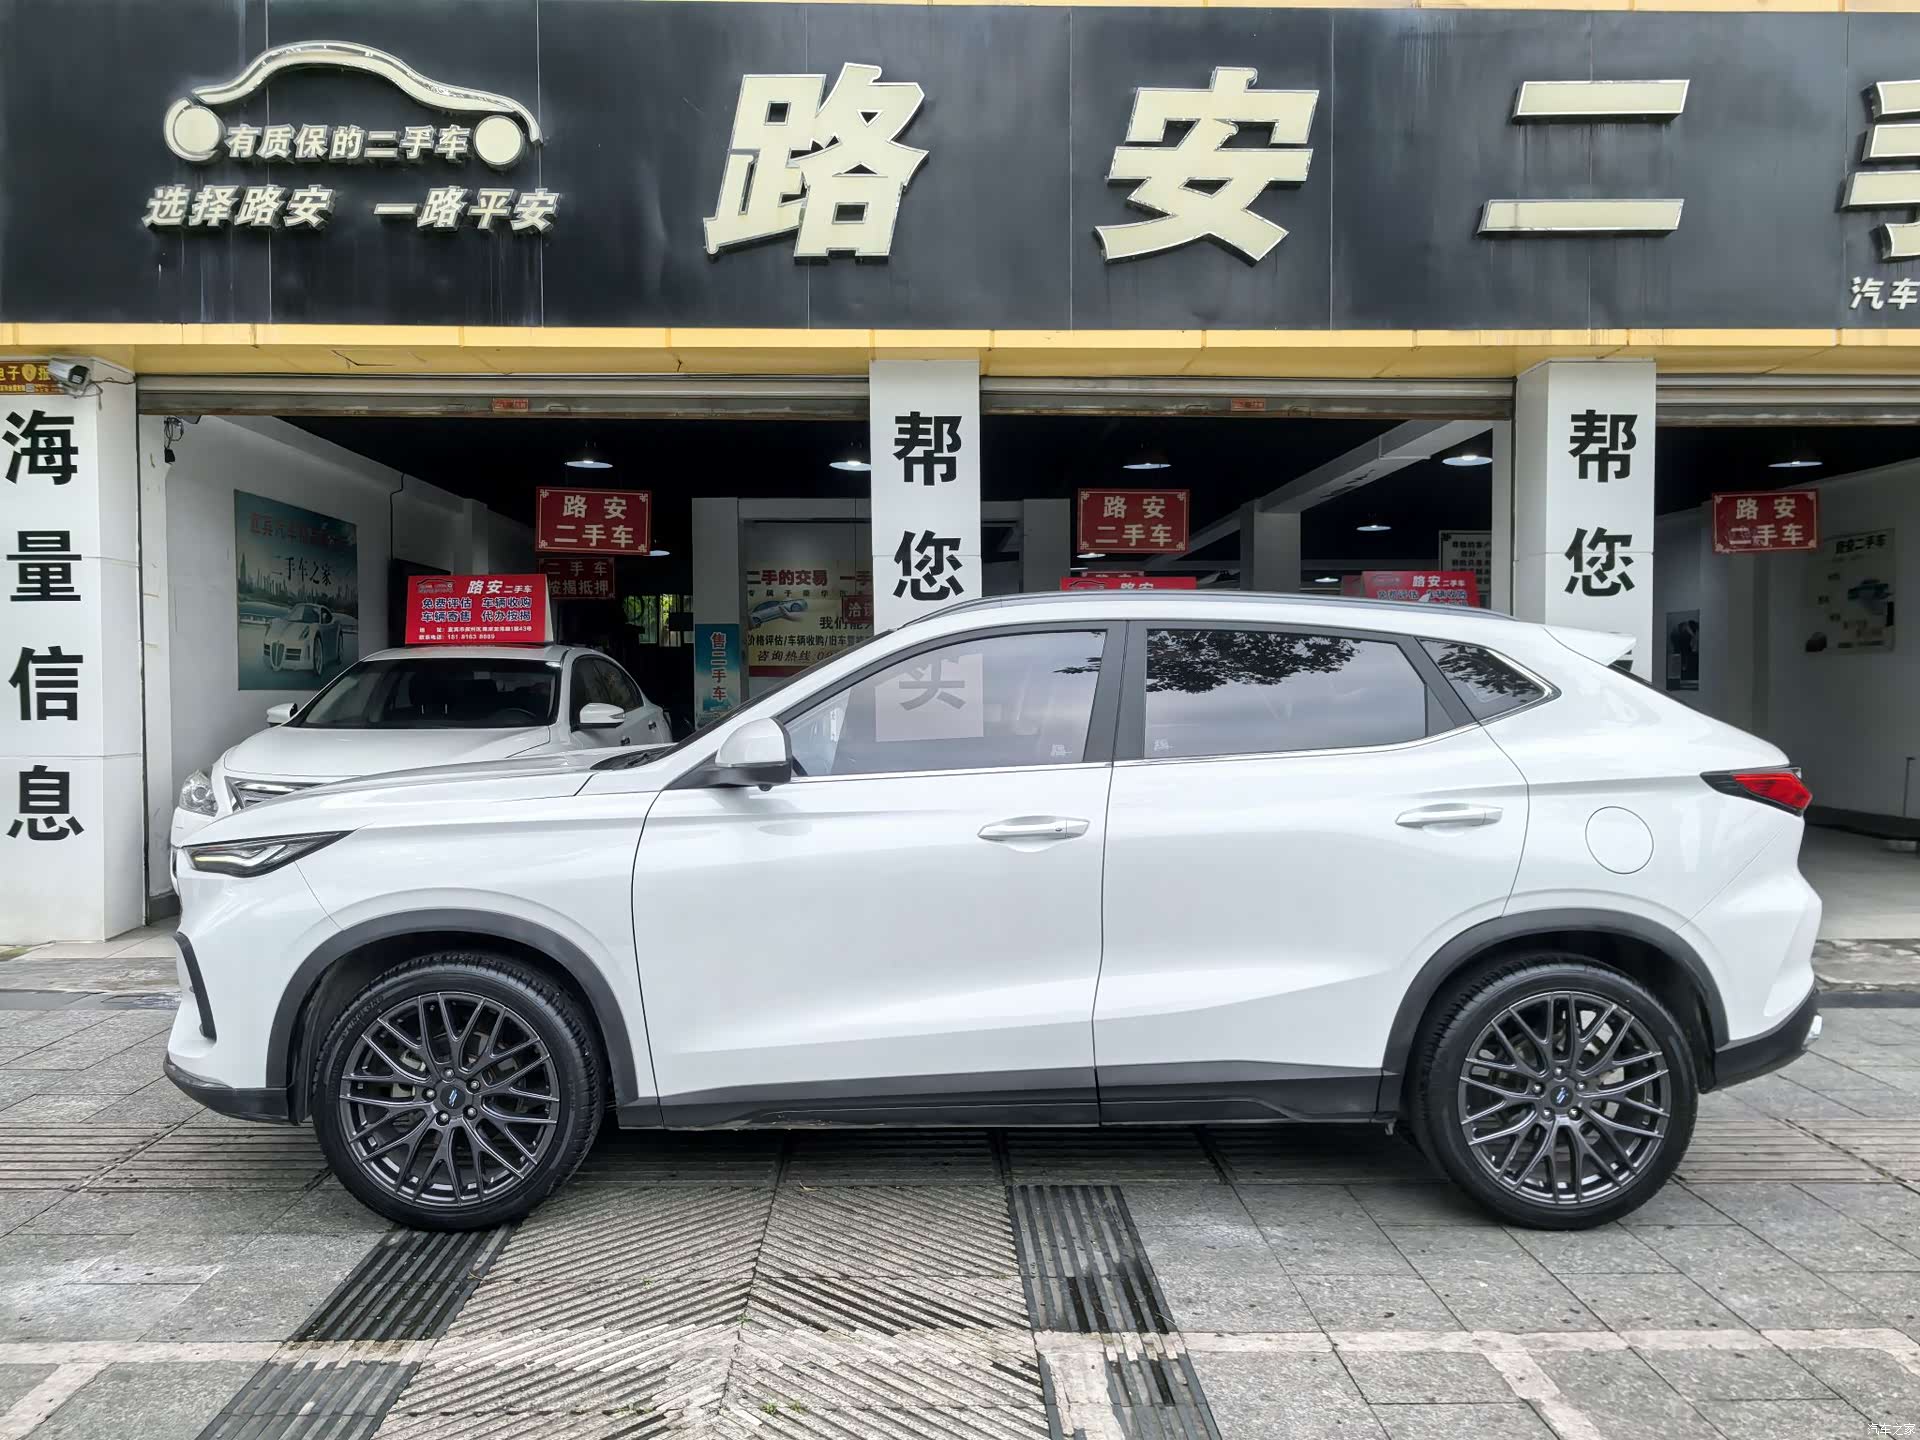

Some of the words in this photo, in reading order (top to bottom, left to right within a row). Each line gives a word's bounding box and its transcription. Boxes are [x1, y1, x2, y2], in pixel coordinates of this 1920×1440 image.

[225, 124, 471, 161] 有质保的二手车
[145, 183, 335, 230] 选择路安
[374, 186, 560, 232] 一路平安
[1849, 276, 1920, 311] 汽车
[562, 495, 628, 519] 路安
[1103, 495, 1166, 519] 路安
[1735, 496, 1797, 520] 路安
[554, 524, 634, 548] 二手车
[1095, 524, 1173, 547] 二手车
[1564, 409, 1638, 671] 帮您
[1729, 524, 1804, 546] 二手车
[546, 559, 608, 577] 二手车
[747, 569, 828, 586] 二手的交易
[467, 580, 533, 595] 路安二手车
[422, 598, 472, 609] 免费评估
[481, 597, 532, 609] 车辆收购
[2, 409, 85, 841] 海量信息
[421, 611, 472, 623] 车辆寄售
[481, 610, 532, 622] 代办按揭
[710, 631, 728, 702] 售二手车
[757, 650, 811, 662] 咨询热线
